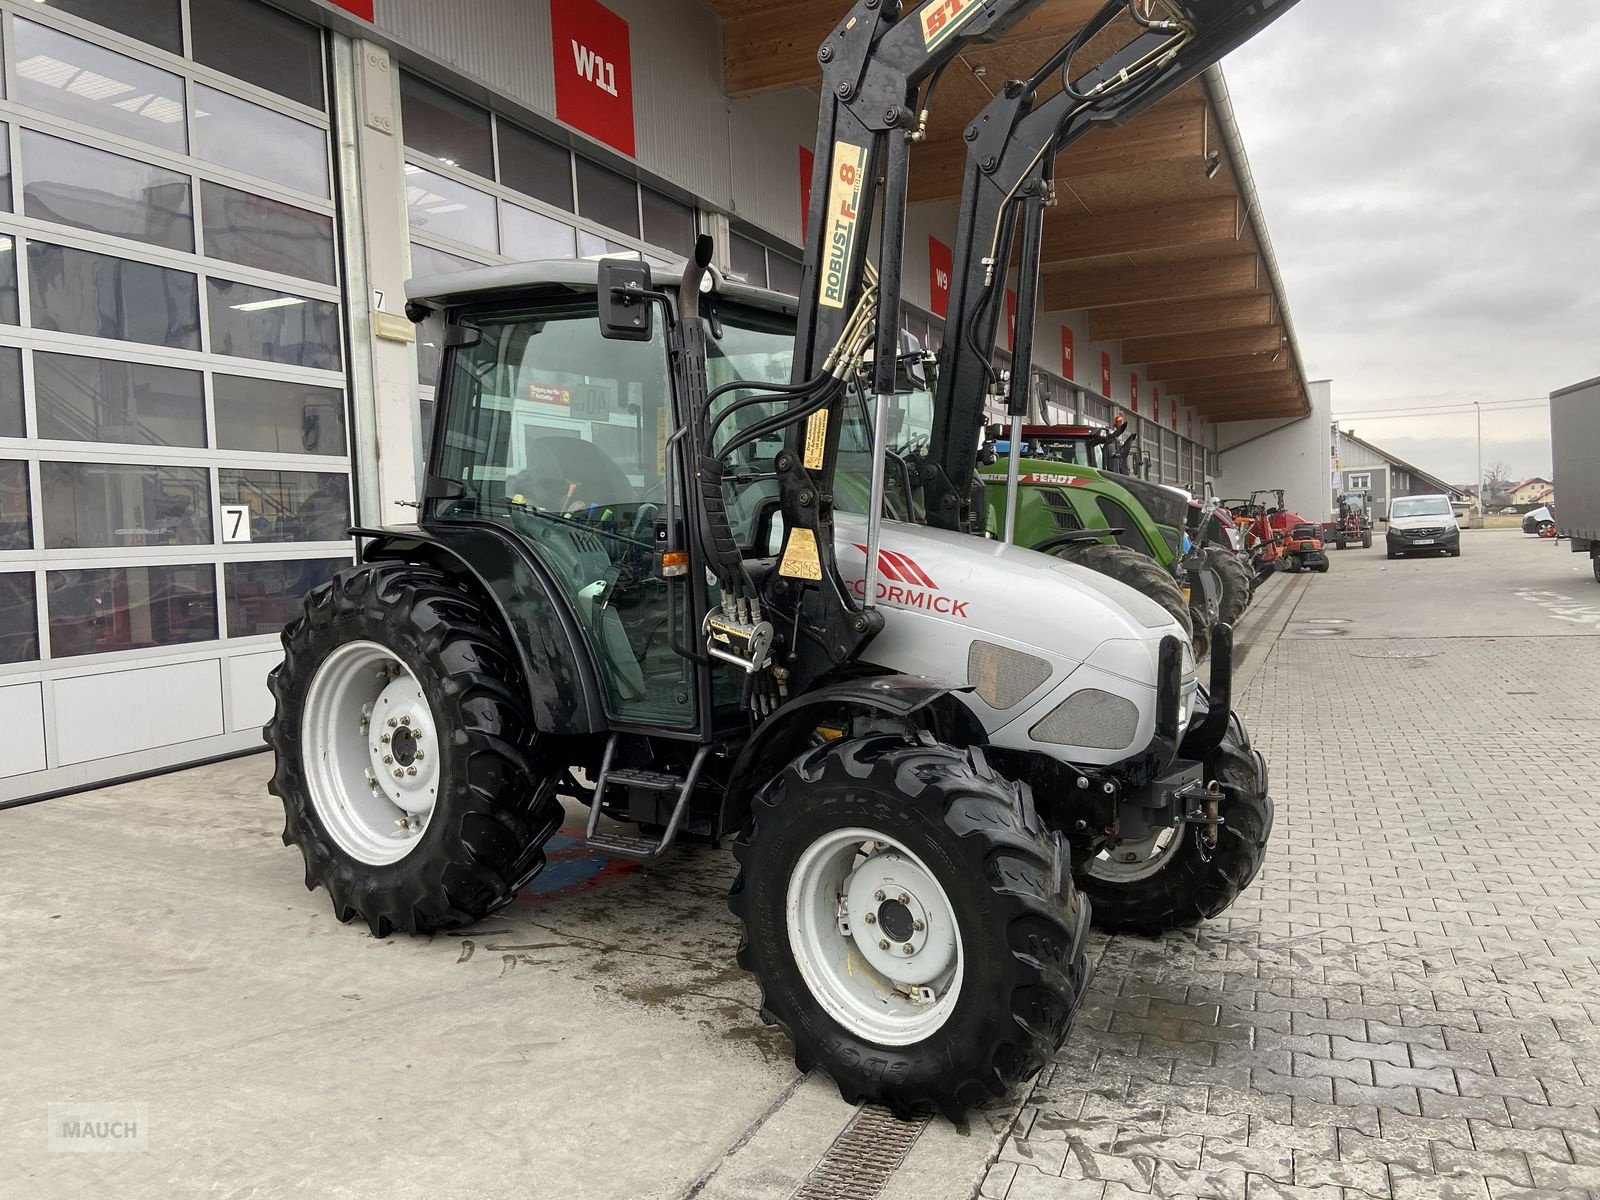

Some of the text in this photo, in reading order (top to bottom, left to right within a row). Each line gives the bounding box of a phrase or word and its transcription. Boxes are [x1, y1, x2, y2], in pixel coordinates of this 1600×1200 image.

[927, 0, 971, 37] ST
[571, 39, 618, 98] W11
[825, 163, 857, 301] ROBUST F 8
[936, 268, 948, 290] W9
[374, 290, 384, 309] 7
[1032, 473, 1077, 485] FENDT
[226, 510, 243, 539] 7
[845, 579, 970, 618] cCORMICK
